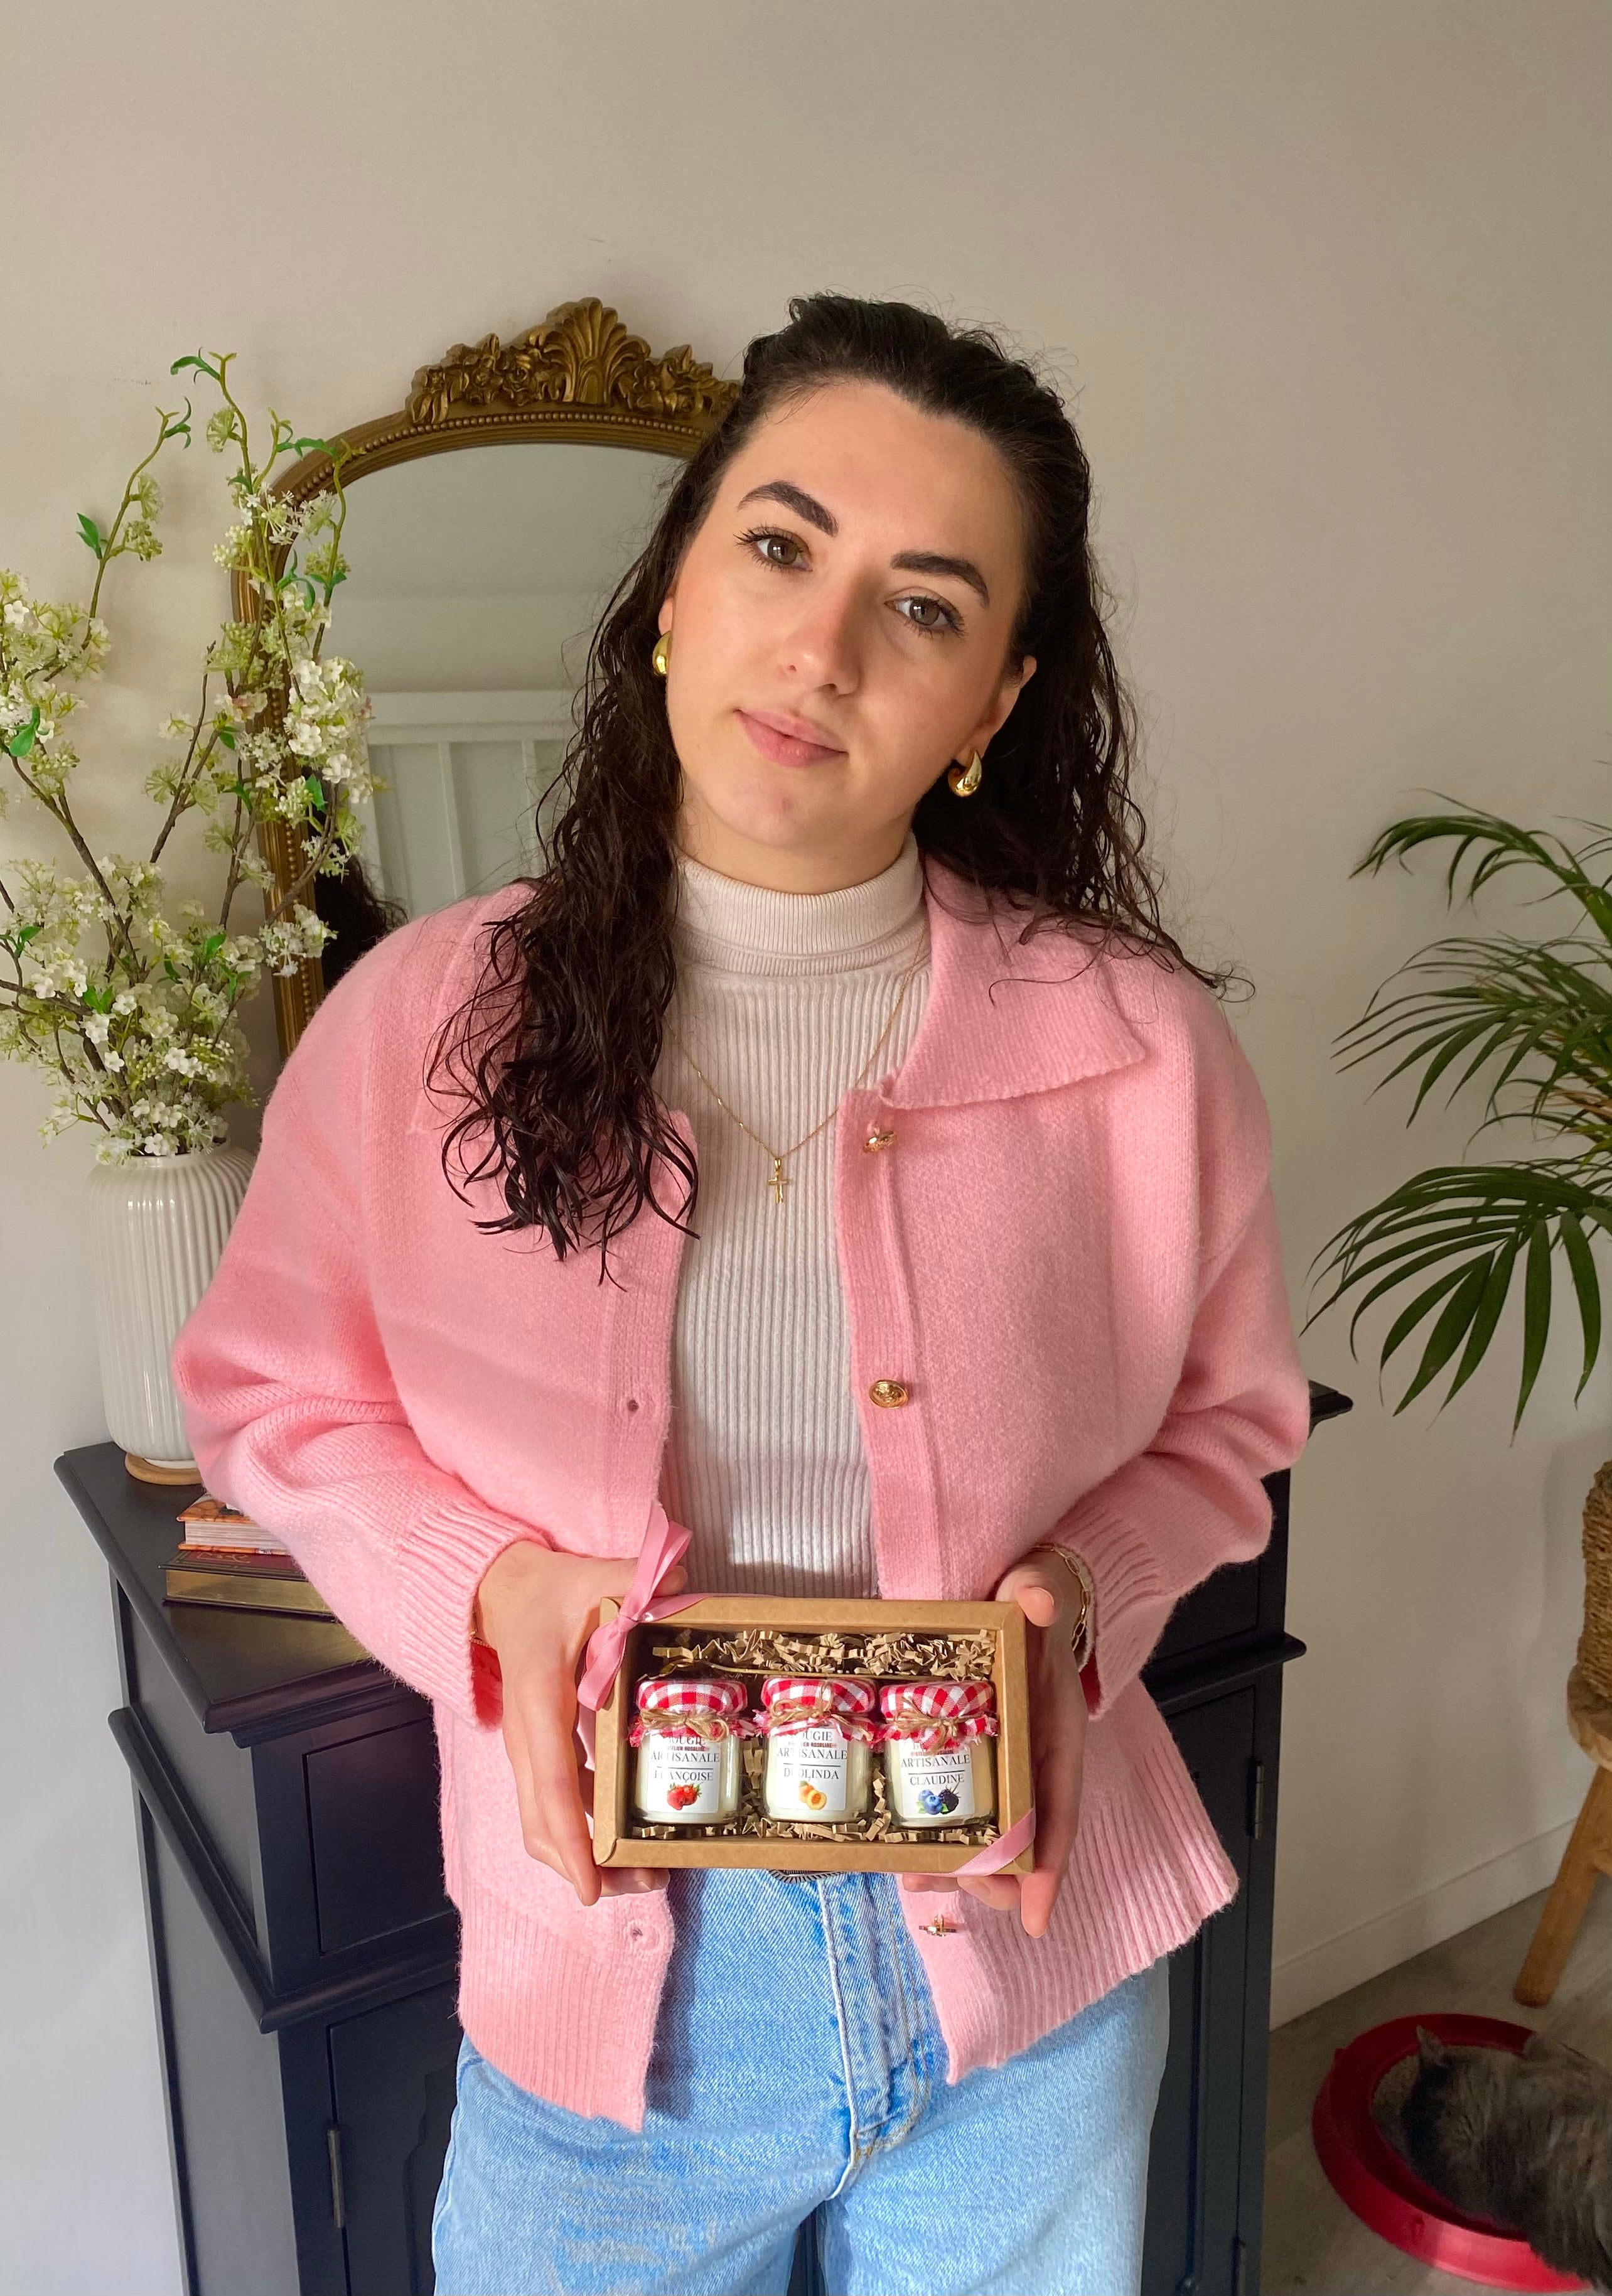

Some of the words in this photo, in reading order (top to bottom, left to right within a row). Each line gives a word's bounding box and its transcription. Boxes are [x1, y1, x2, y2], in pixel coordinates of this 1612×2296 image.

[669, 1735, 706, 1745] OUGIE
[792, 1730, 833, 1742] UGIE
[901, 1754, 970, 1768] ARTISANALE
[655, 1770, 714, 1784] FANÇOISE
[783, 1767, 839, 1779] DOLINDA
[910, 1773, 965, 1786] CLAUDINE
